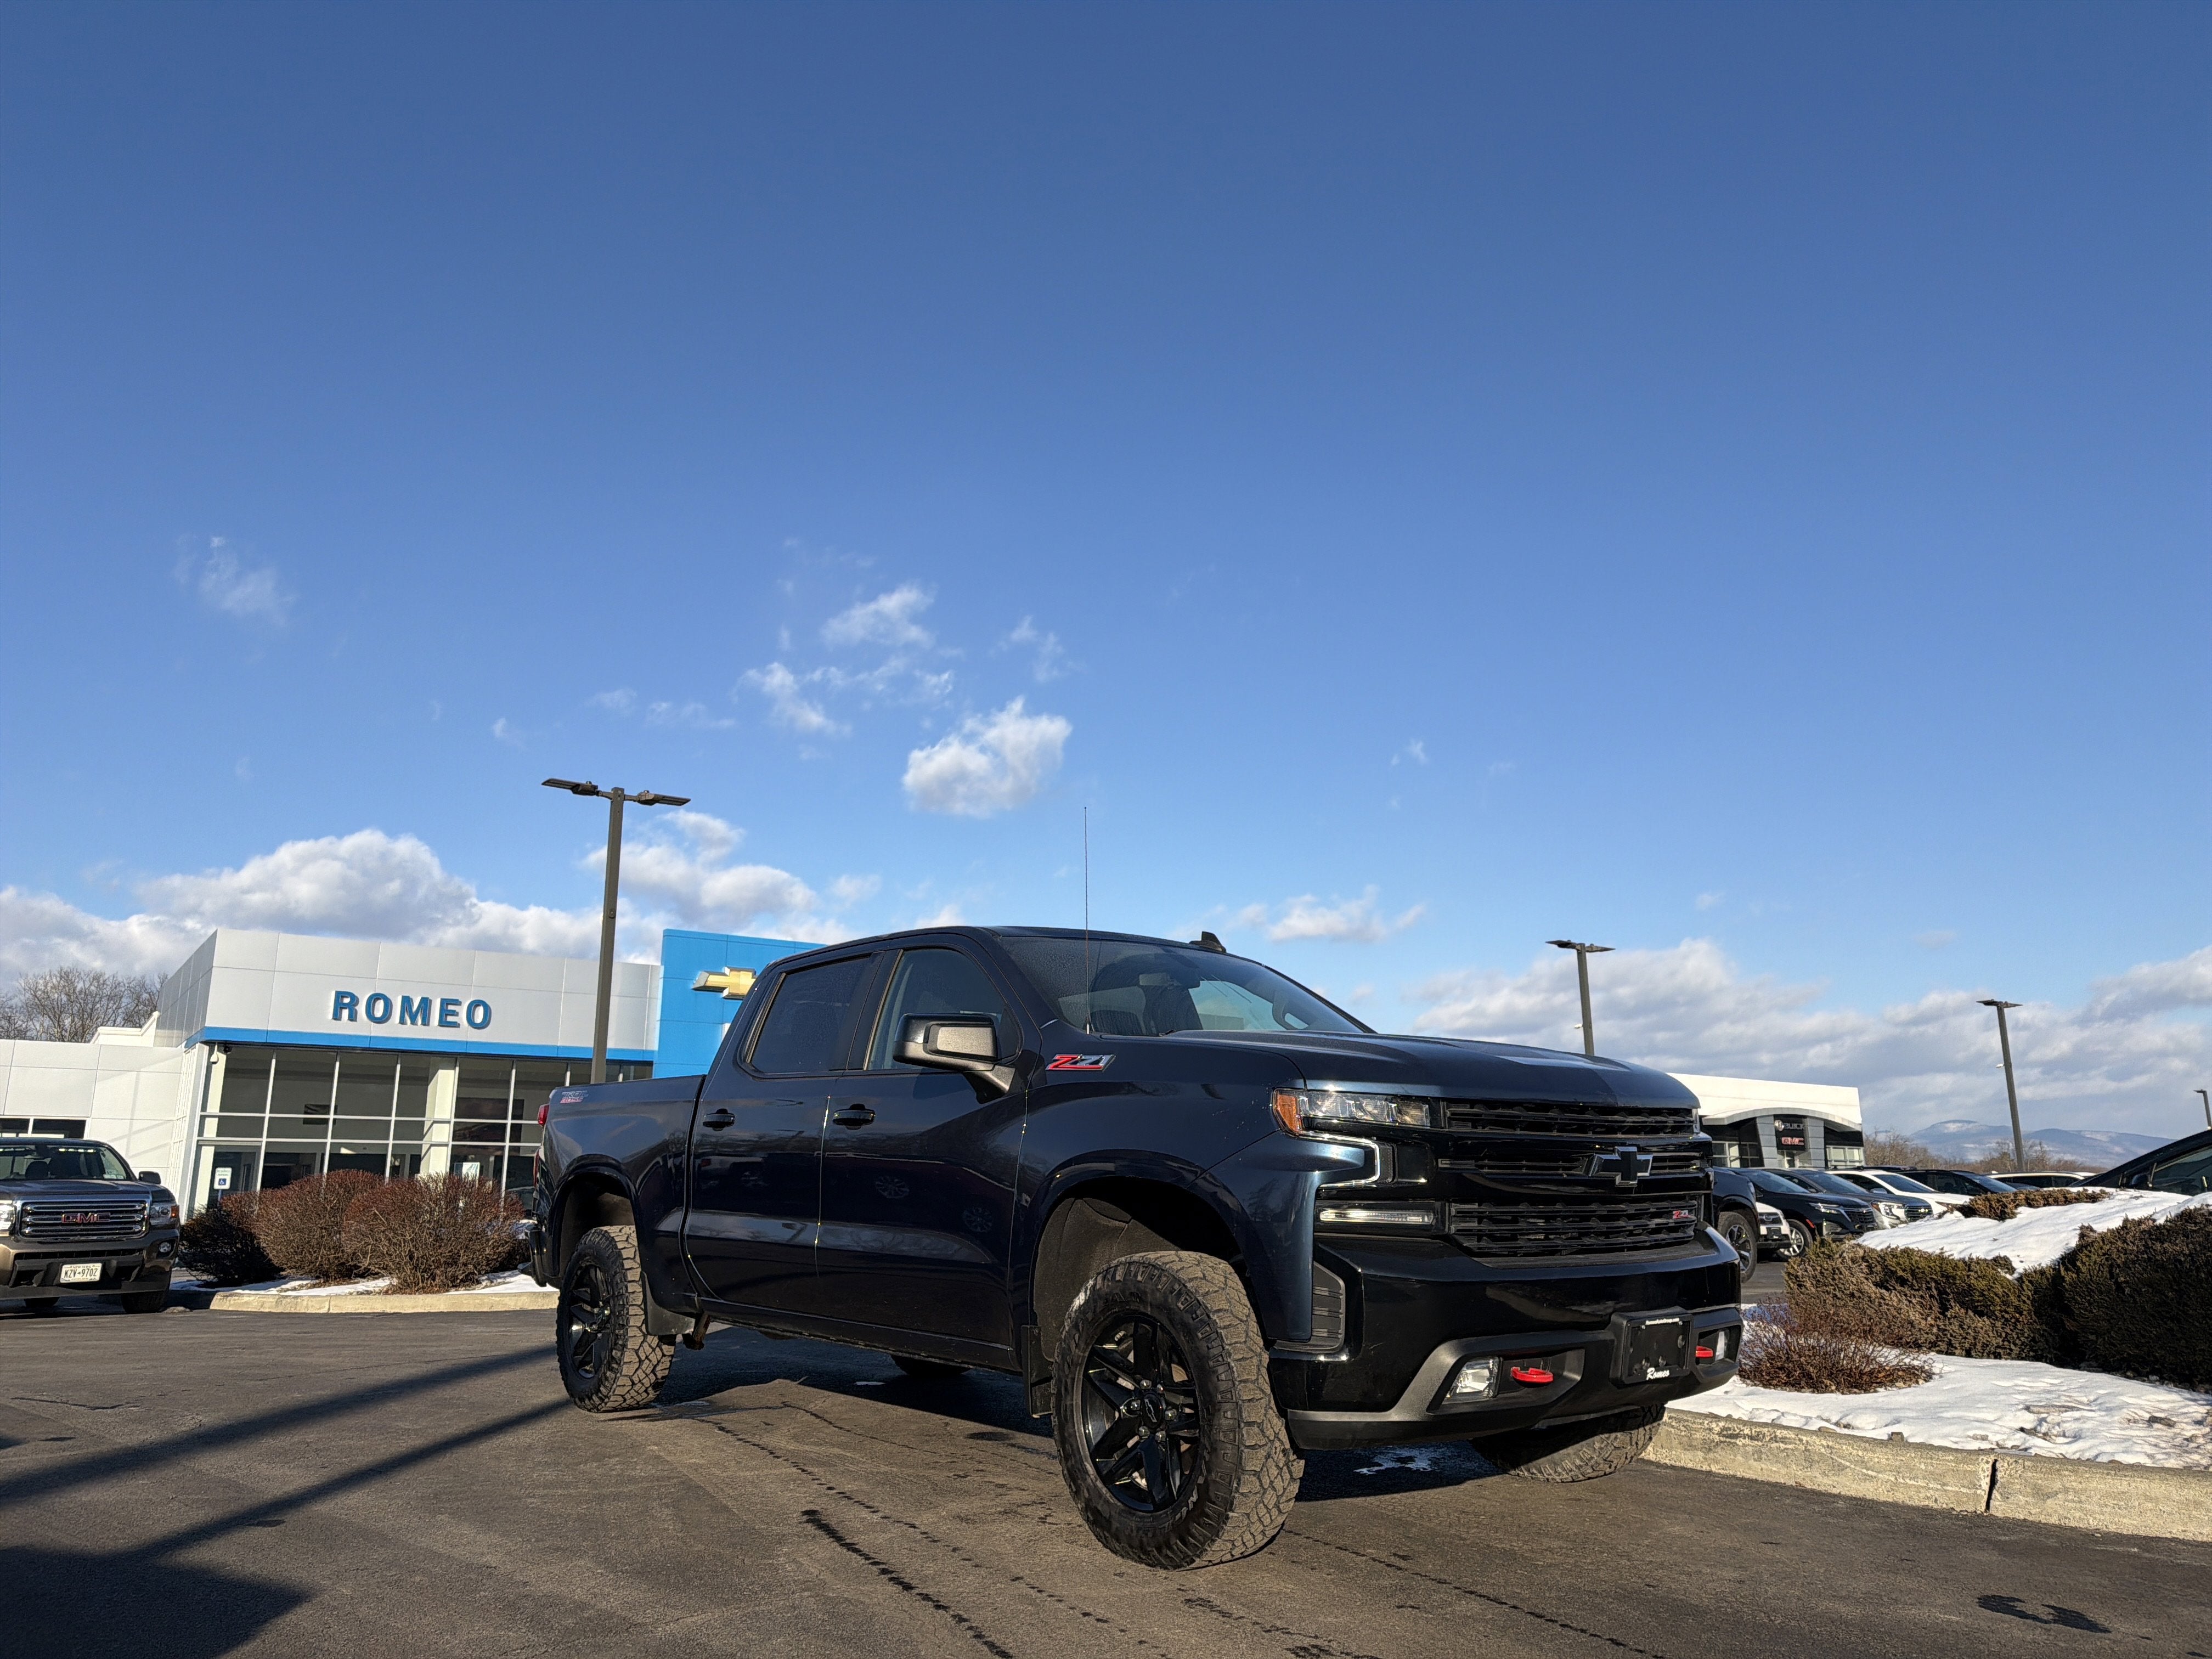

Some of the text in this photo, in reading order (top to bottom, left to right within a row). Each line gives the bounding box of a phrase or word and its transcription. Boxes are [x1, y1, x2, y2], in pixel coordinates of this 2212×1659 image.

[331, 990, 492, 1030] ROMEO
[1045, 1053, 1116, 1071] Z71
[1781, 1137, 1804, 1146] GMC
[61, 1212, 111, 1223] GMC
